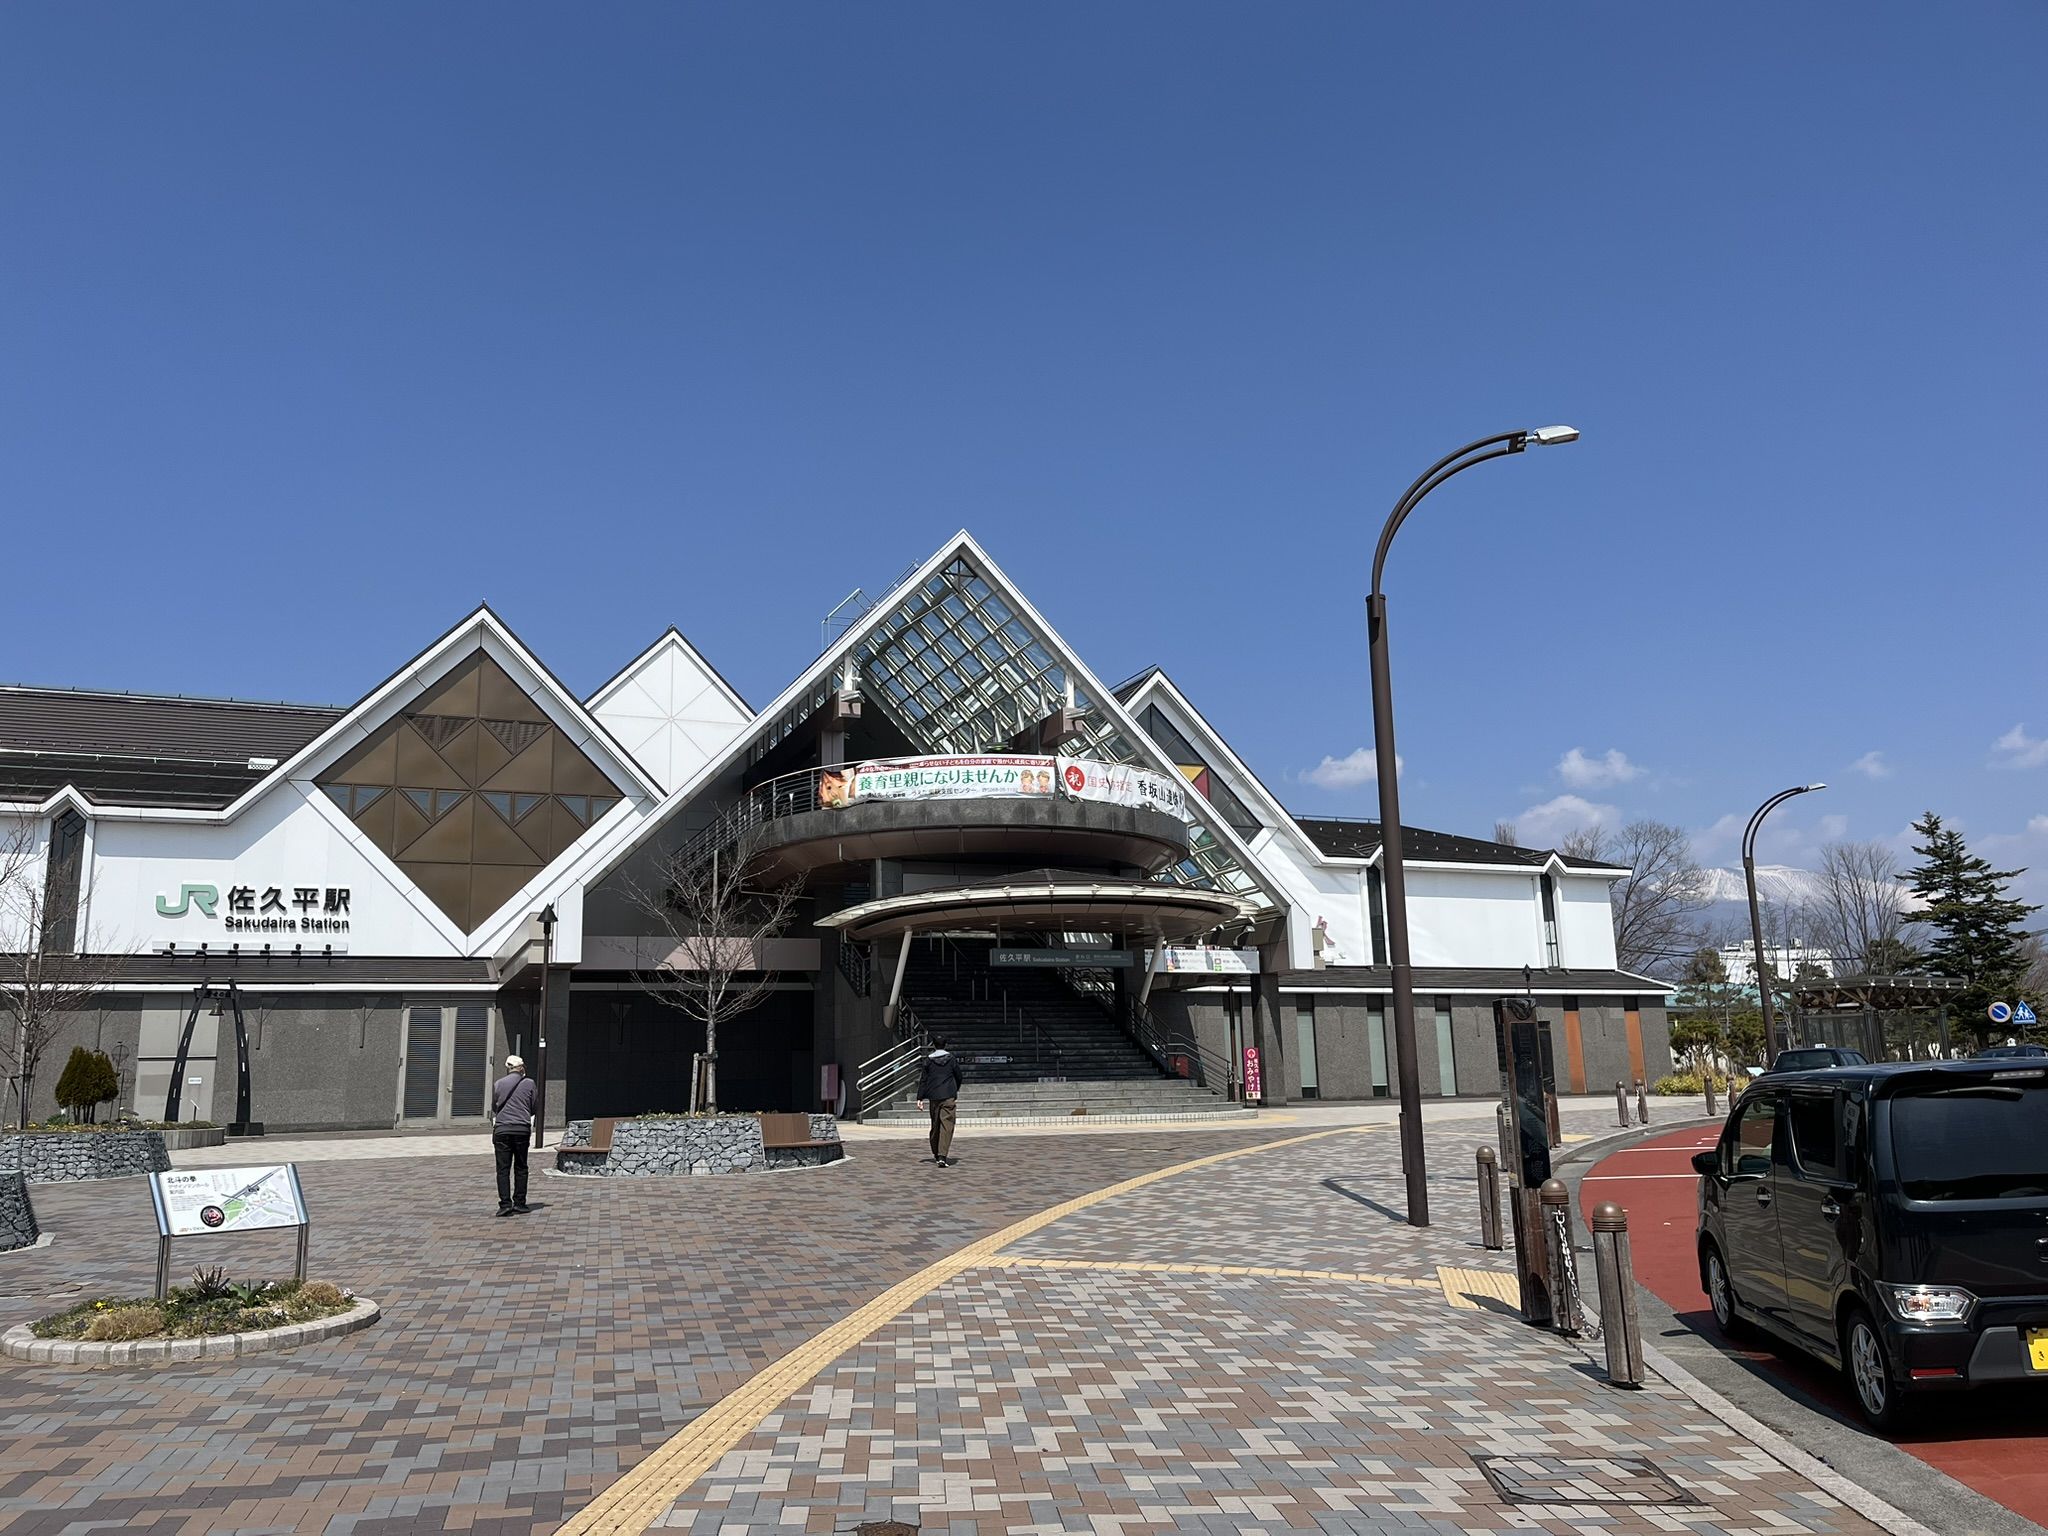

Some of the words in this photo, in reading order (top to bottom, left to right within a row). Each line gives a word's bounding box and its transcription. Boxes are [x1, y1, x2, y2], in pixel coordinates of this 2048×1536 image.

[860, 769, 1019, 790] 養育里親になりませんか
[1067, 771, 1082, 787] 祝
[1088, 776, 1132, 793] 国史指定
[156, 884, 219, 917] JR
[227, 885, 351, 913] 佐久平駅
[225, 916, 296, 930] Sakudaira
[301, 917, 350, 930] Station
[999, 953, 1031, 962] 佐久平駅
